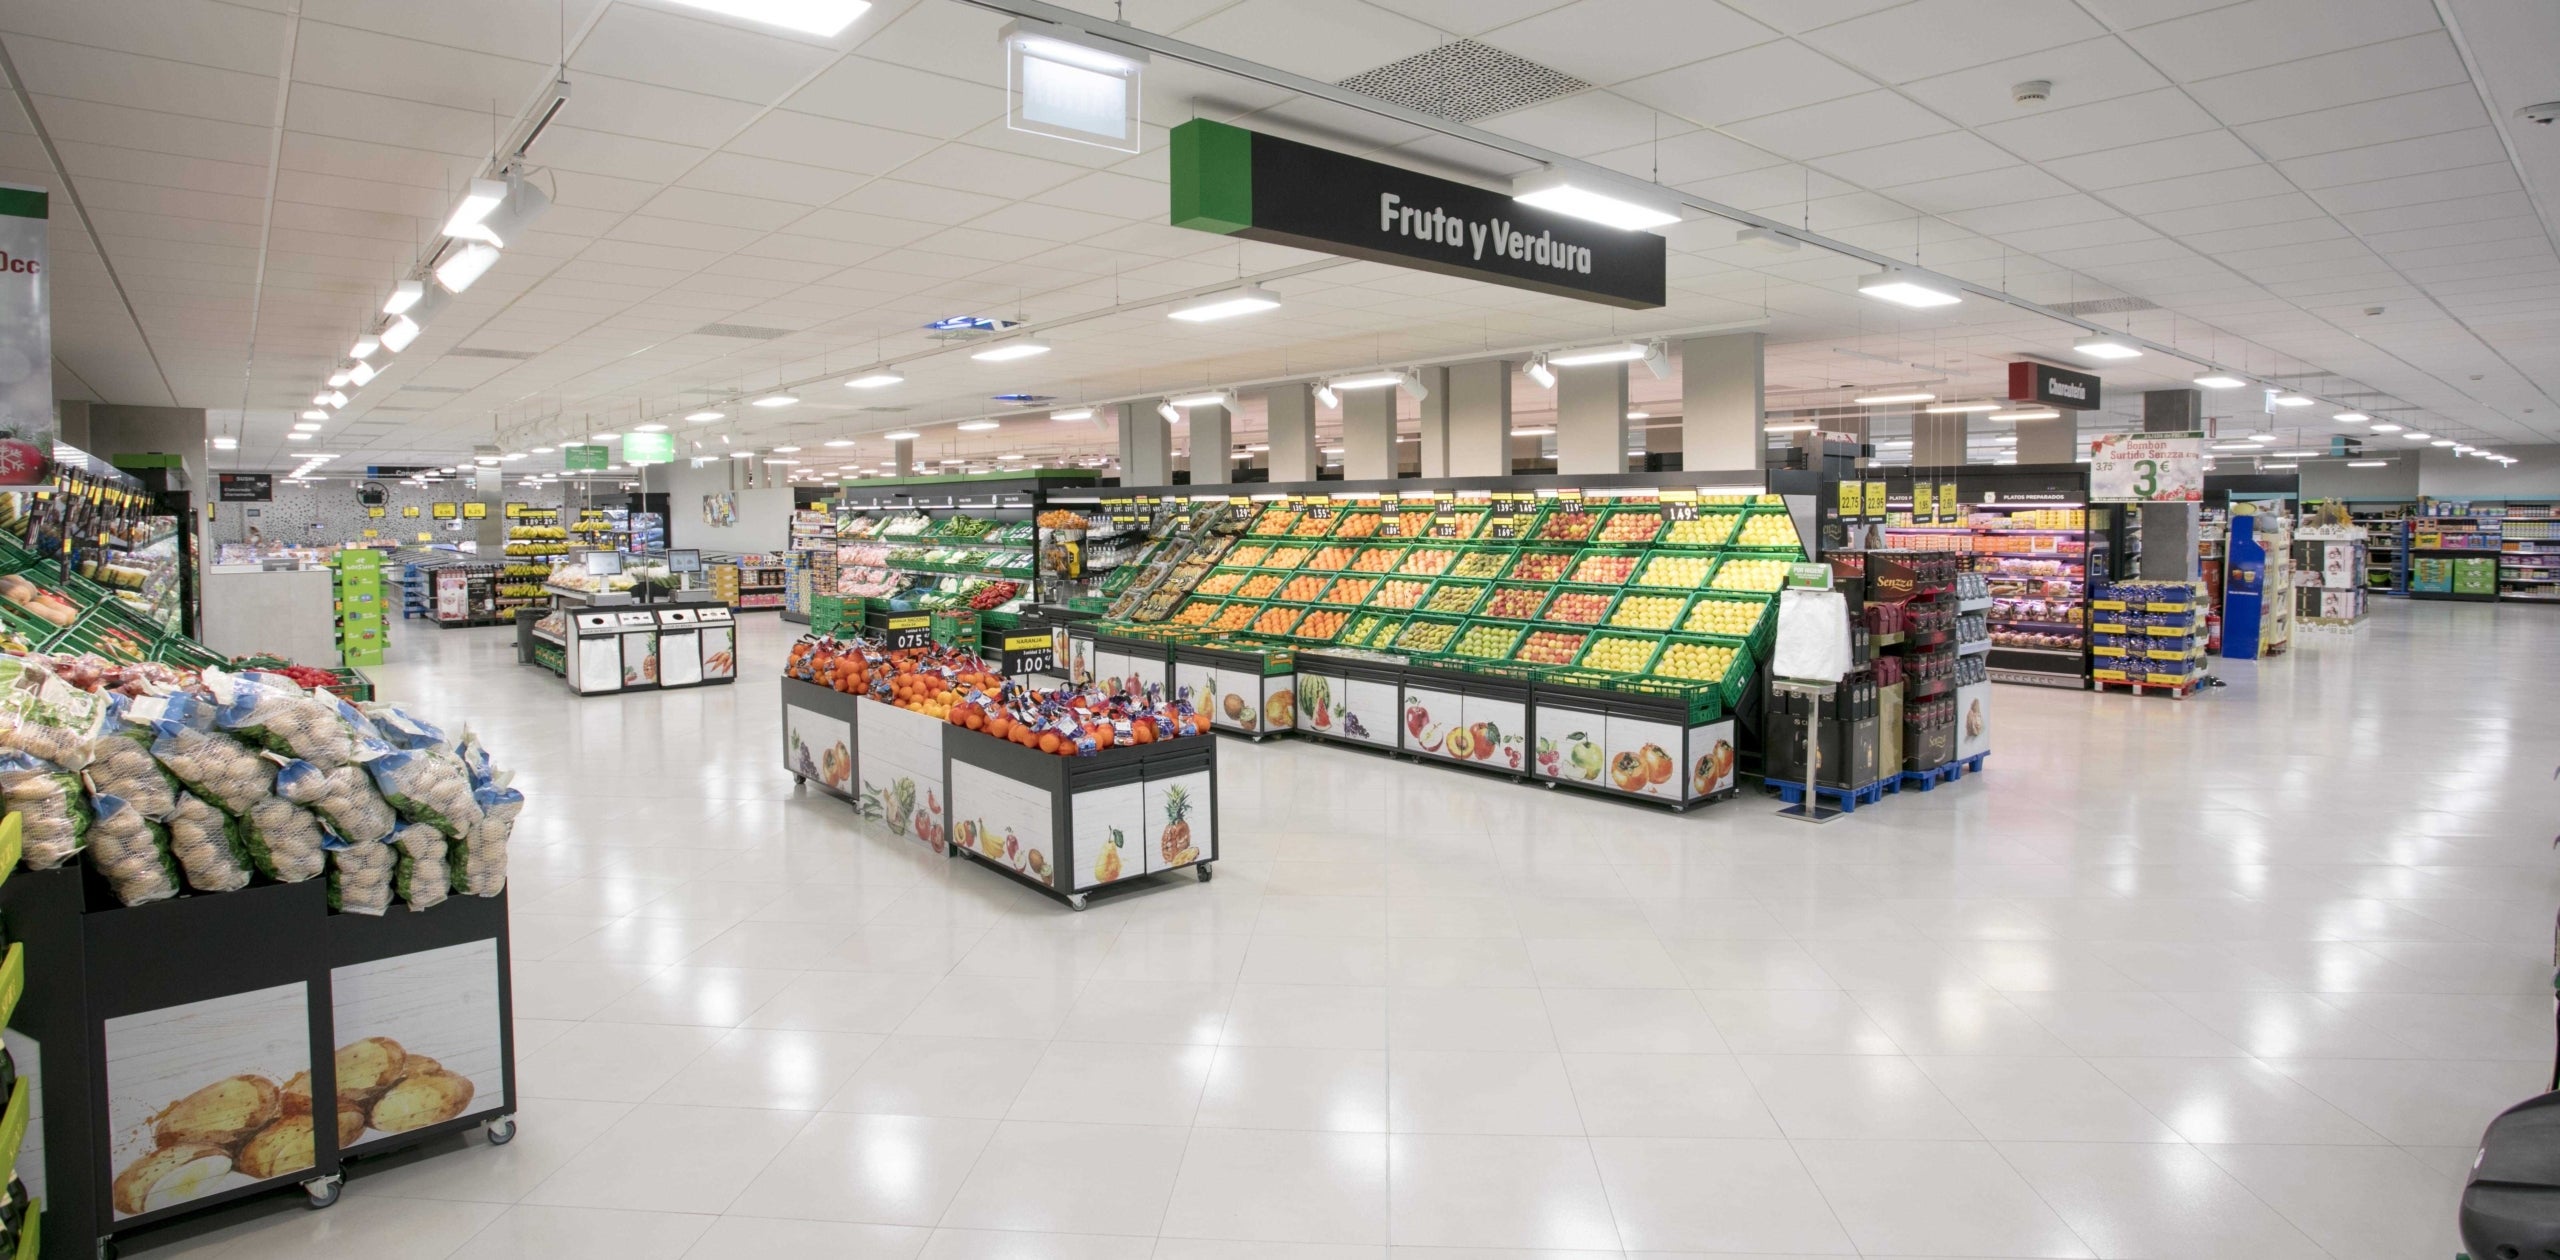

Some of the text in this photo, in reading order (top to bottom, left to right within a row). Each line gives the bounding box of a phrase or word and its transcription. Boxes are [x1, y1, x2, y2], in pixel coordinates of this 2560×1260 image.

[1381, 192, 1592, 275] Fruta y Verdura
[2110, 450, 2145, 460] Surtido
[2148, 450, 2183, 459] Senzza
[2133, 459, 2157, 497] 3
[2160, 460, 2170, 473] €
[1877, 576, 1913, 592] Senzza
